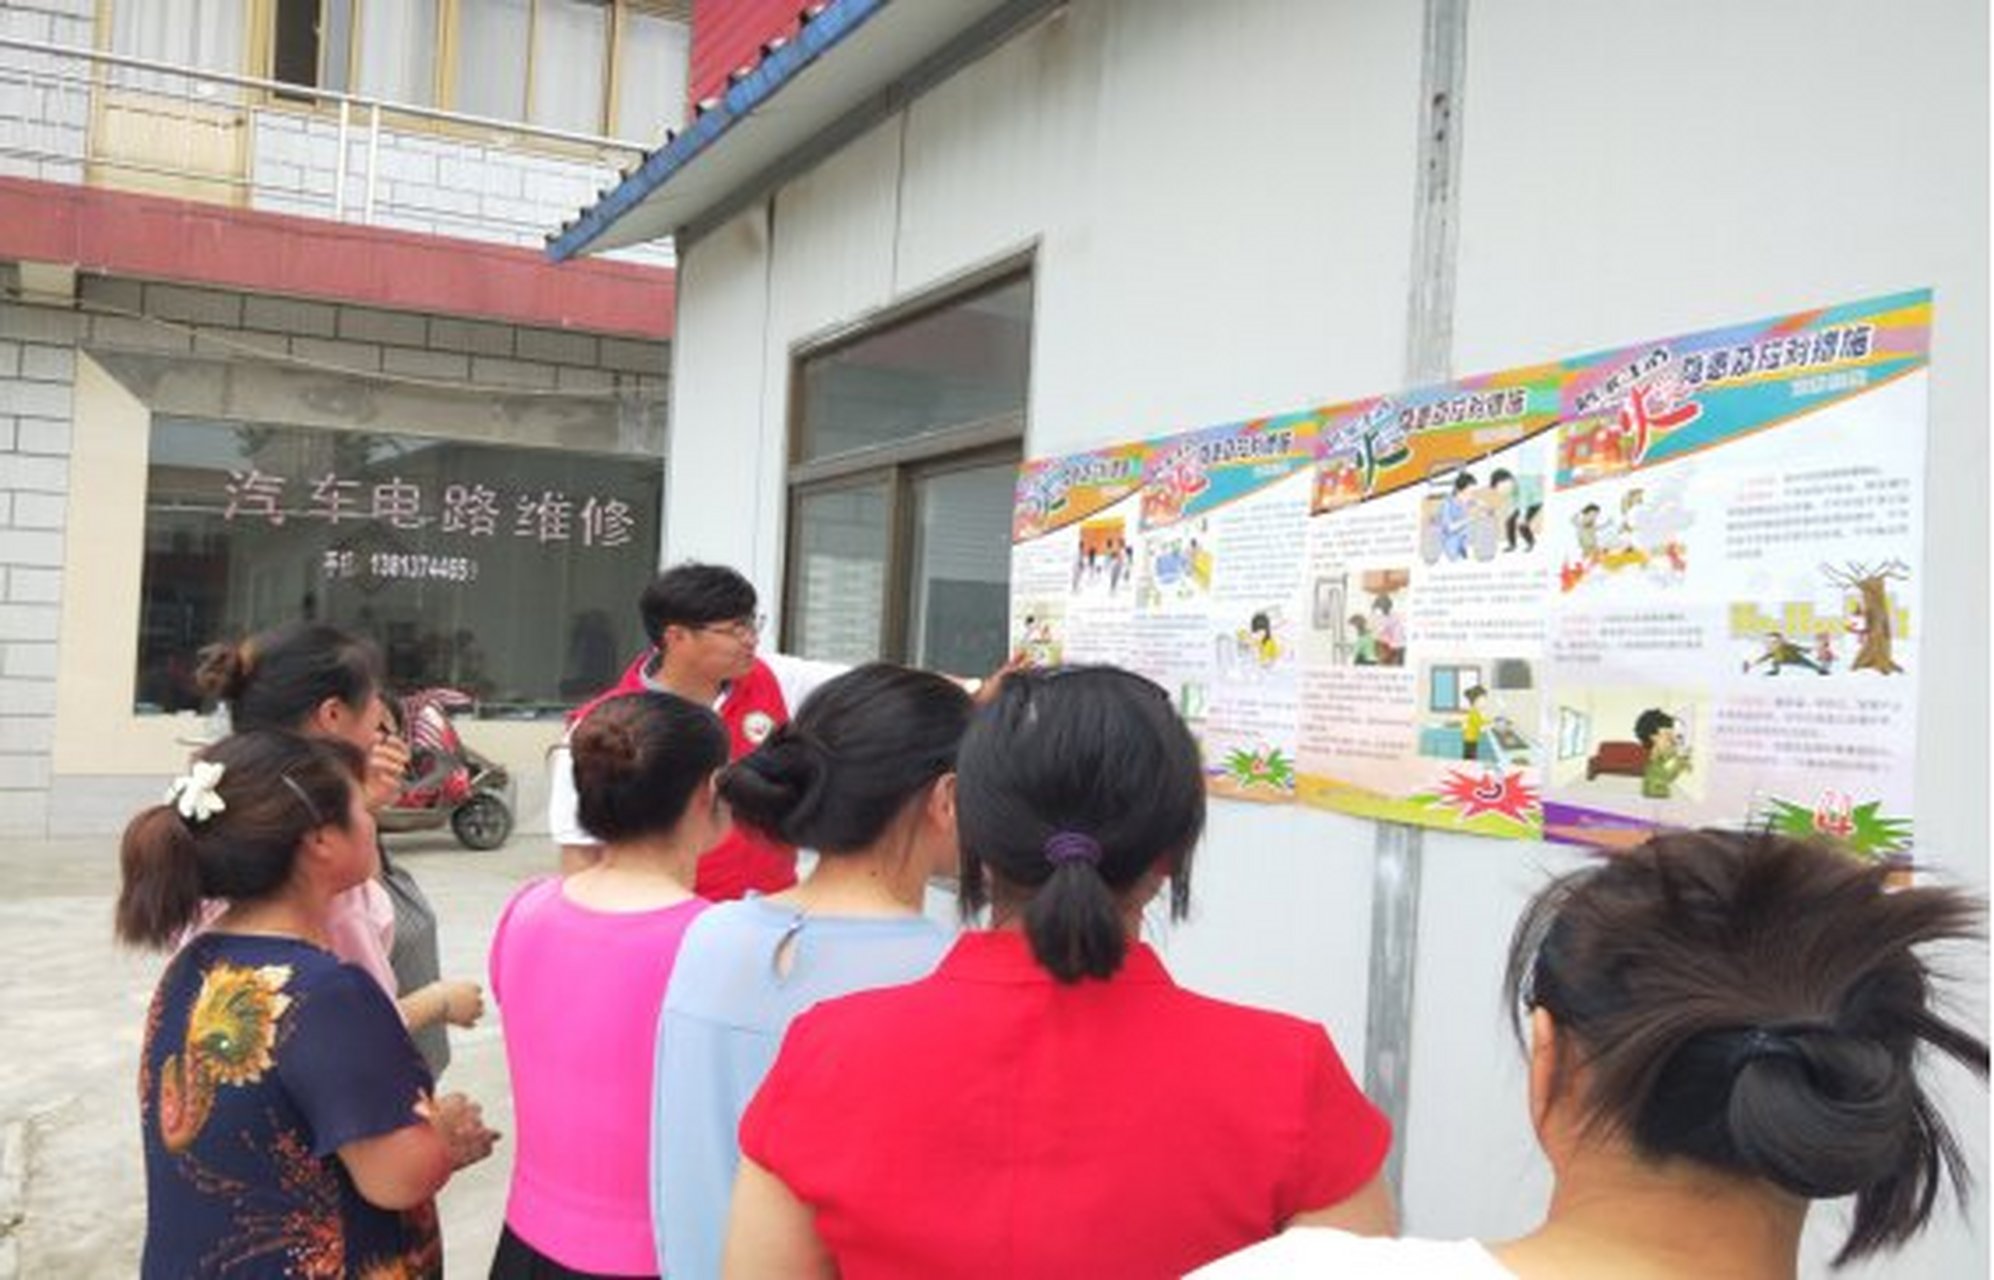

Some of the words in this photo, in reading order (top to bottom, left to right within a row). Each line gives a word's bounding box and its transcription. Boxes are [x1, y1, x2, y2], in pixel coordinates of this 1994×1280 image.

[224, 469, 635, 547] 汽车电路维修
